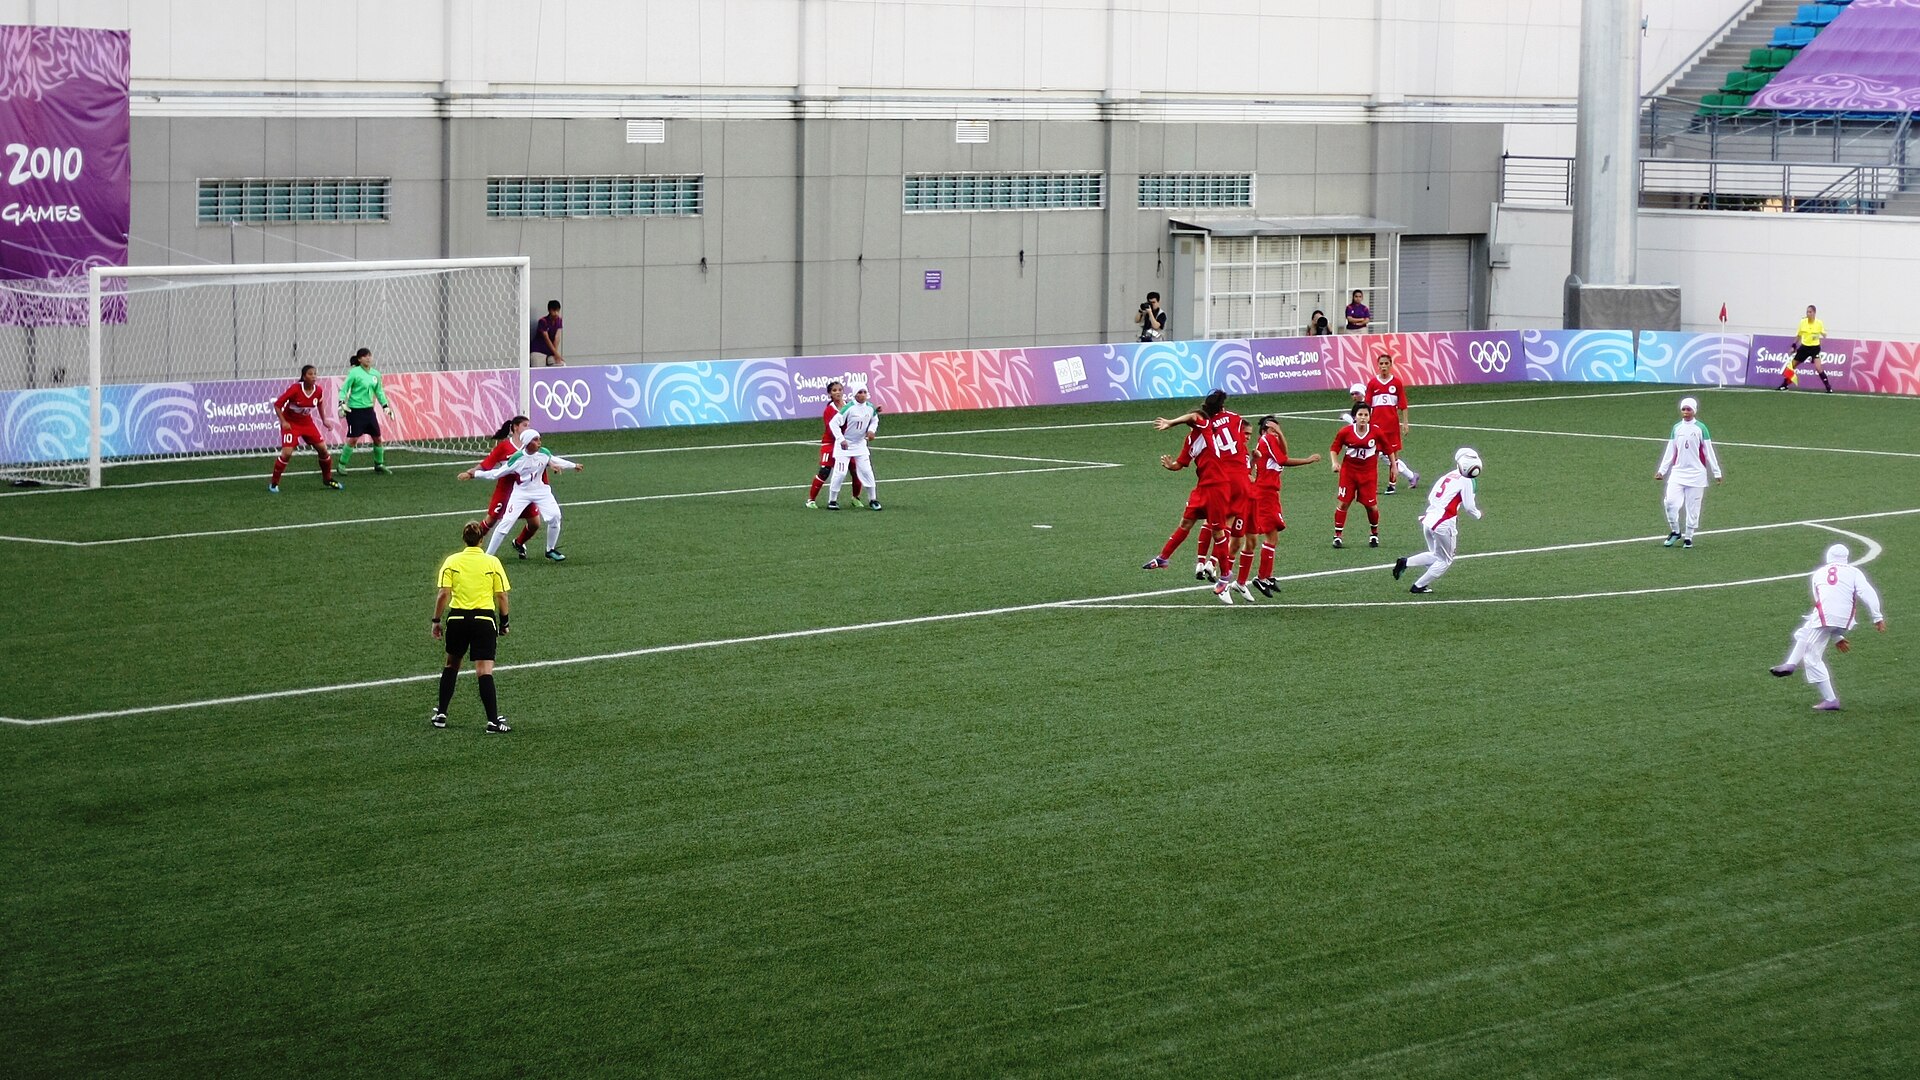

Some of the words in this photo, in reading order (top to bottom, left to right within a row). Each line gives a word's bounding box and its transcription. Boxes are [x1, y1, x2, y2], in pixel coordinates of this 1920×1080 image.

[5, 143, 82, 186] 2010
[1, 202, 81, 226] GAMES
[1299, 351, 1319, 366] 2010
[1819, 351, 1847, 365] 2010
[1260, 371, 1279, 381] YOUTH
[798, 394, 820, 404] YOUTH
[1382, 395, 1388, 404] 5
[203, 398, 272, 419] SINGAPORE
[208, 423, 236, 435] YOUTH
[238, 421, 273, 433] OLYMPIC
[856, 421, 863, 431] 11
[283, 433, 293, 444] 10
[1211, 427, 1238, 458] 14
[1684, 440, 1690, 450] 6
[822, 452, 830, 463] 11
[1356, 449, 1366, 458] 14
[838, 462, 845, 473] 11
[1435, 477, 1452, 499] 5
[494, 502, 503, 514] 2
[1235, 519, 1244, 530] 8
[1827, 566, 1838, 586] 8
